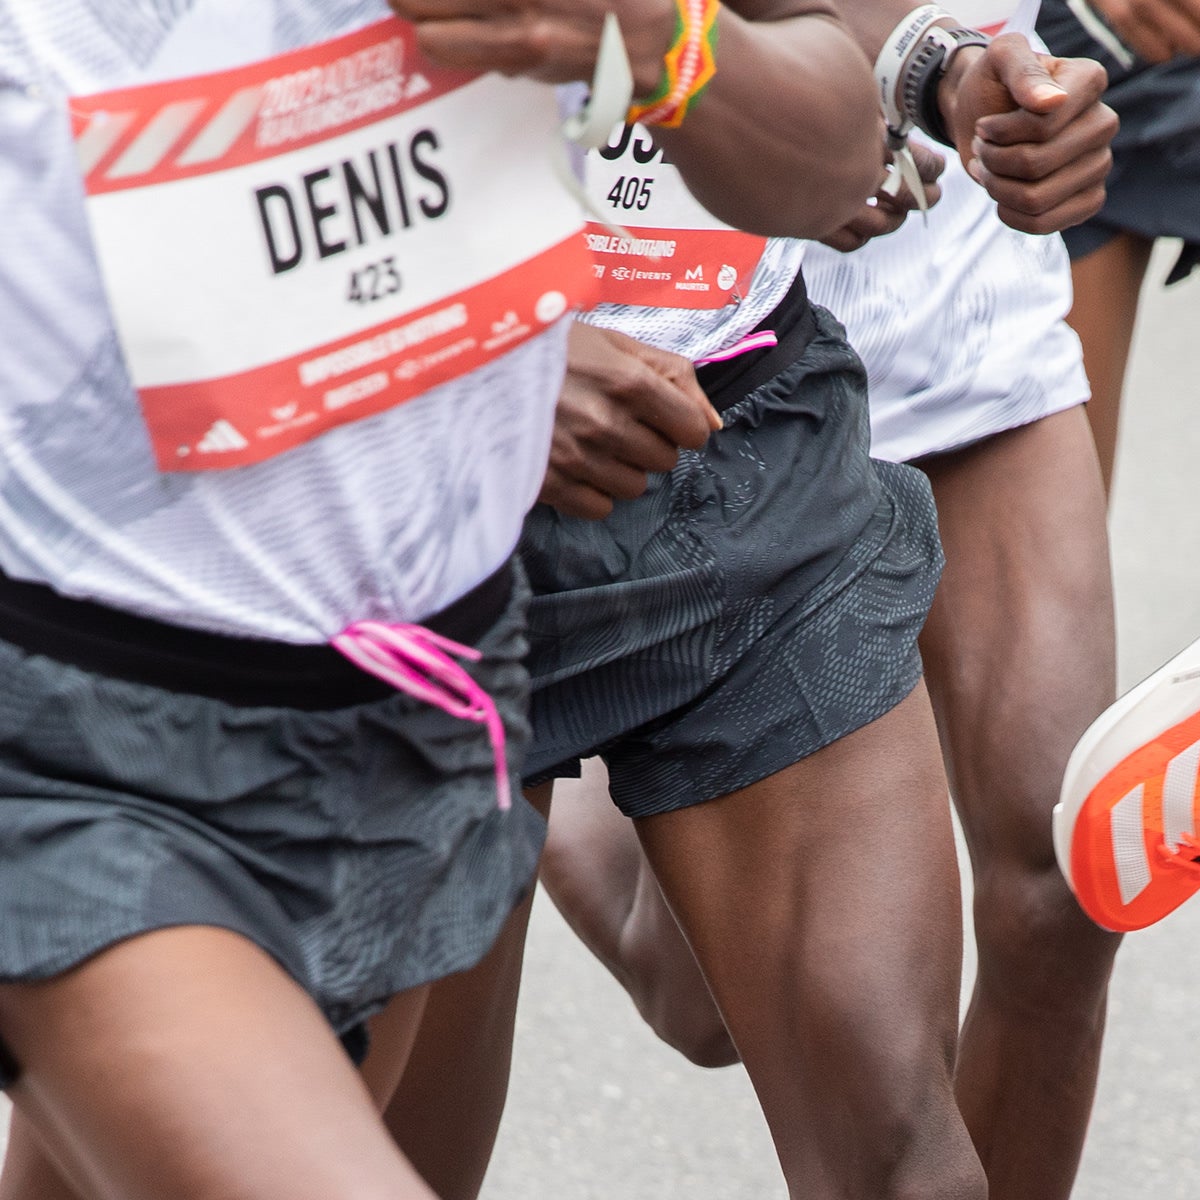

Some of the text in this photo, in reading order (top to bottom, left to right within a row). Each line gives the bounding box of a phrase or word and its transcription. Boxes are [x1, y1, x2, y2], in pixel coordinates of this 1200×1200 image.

[255, 129, 450, 275] DENIS
[607, 175, 655, 211] 405
[583, 233, 619, 255] SIBLE
[630, 239, 677, 258] NOTHING
[348, 256, 401, 305] 423
